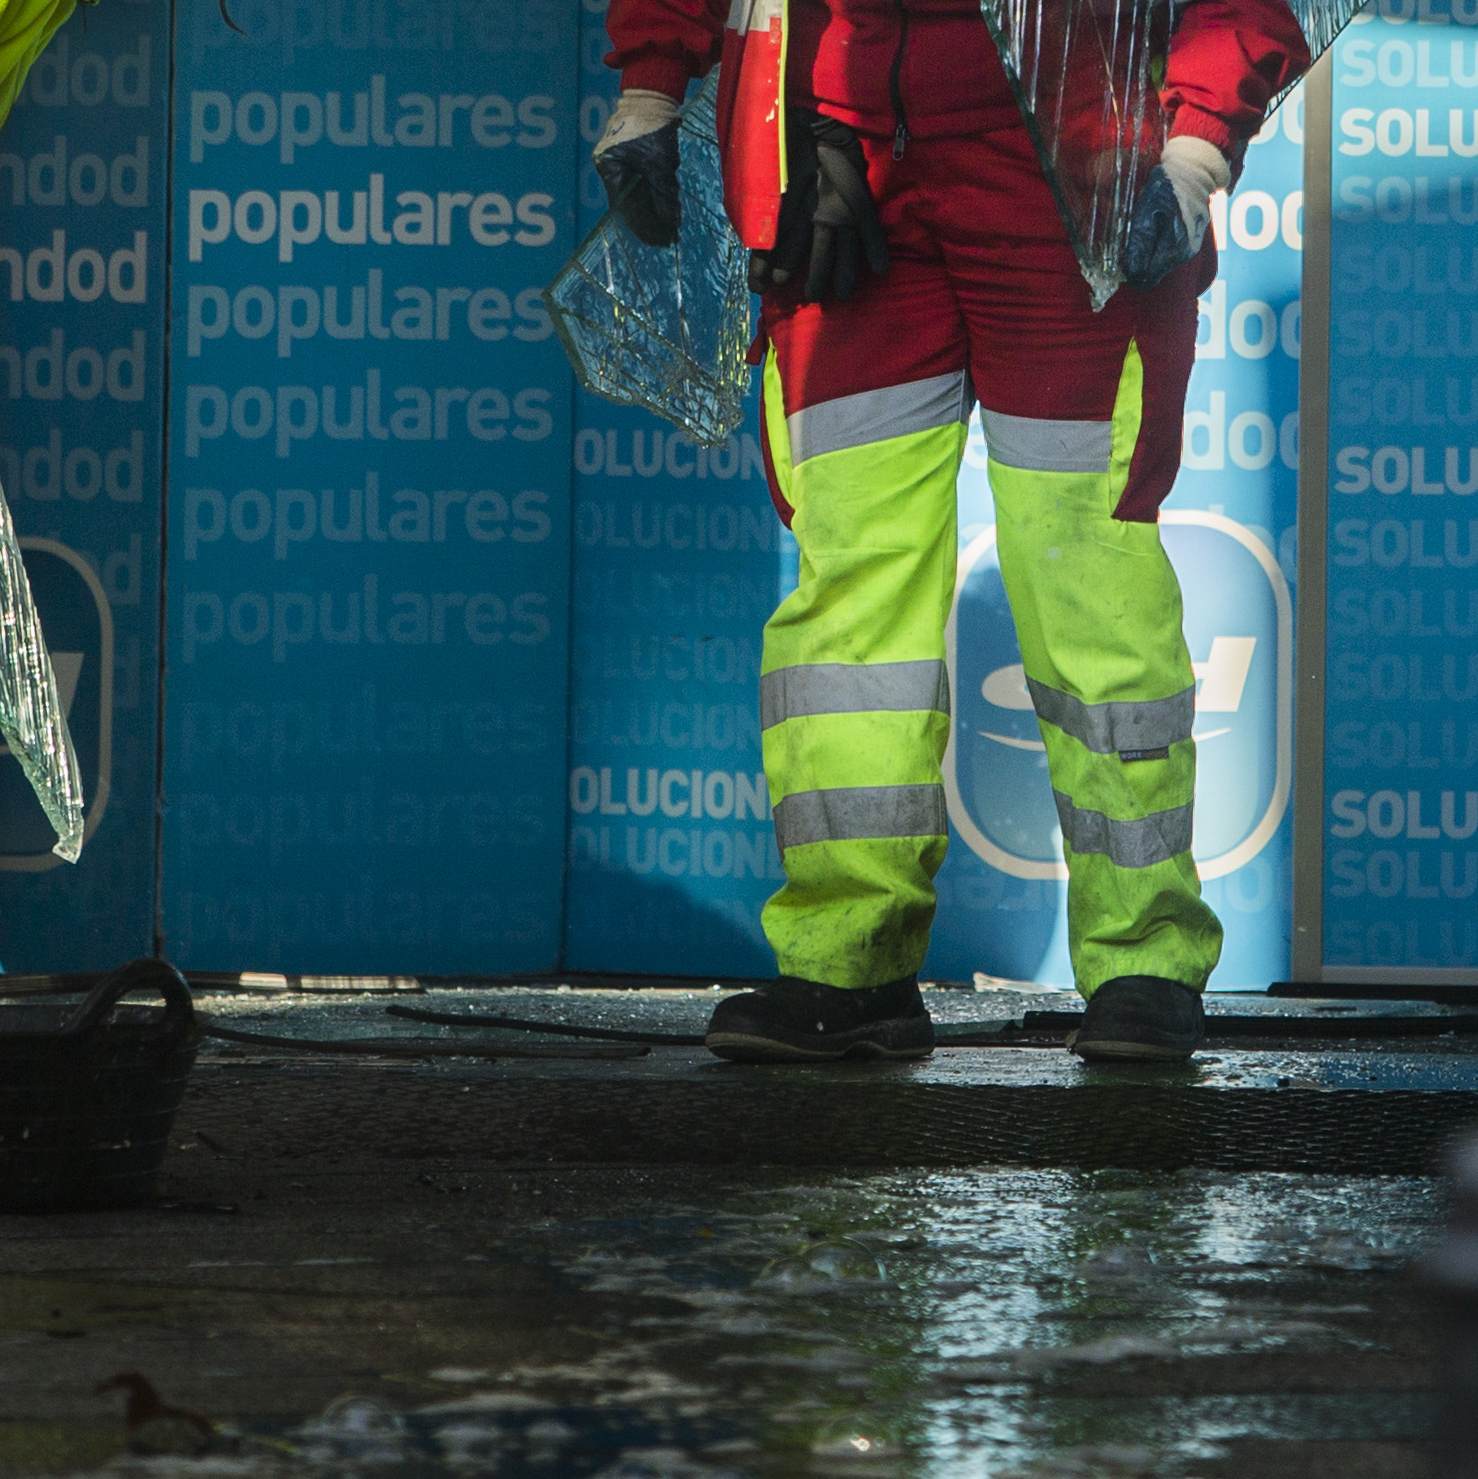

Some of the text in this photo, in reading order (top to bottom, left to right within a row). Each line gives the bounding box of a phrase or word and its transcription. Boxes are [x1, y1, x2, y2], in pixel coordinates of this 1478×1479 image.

[190, 74, 558, 164] populares
[188, 172, 556, 262] populares
[187, 269, 555, 358] populares
[185, 368, 553, 458] populares
[184, 470, 552, 561] populares
[182, 573, 550, 663] populares
